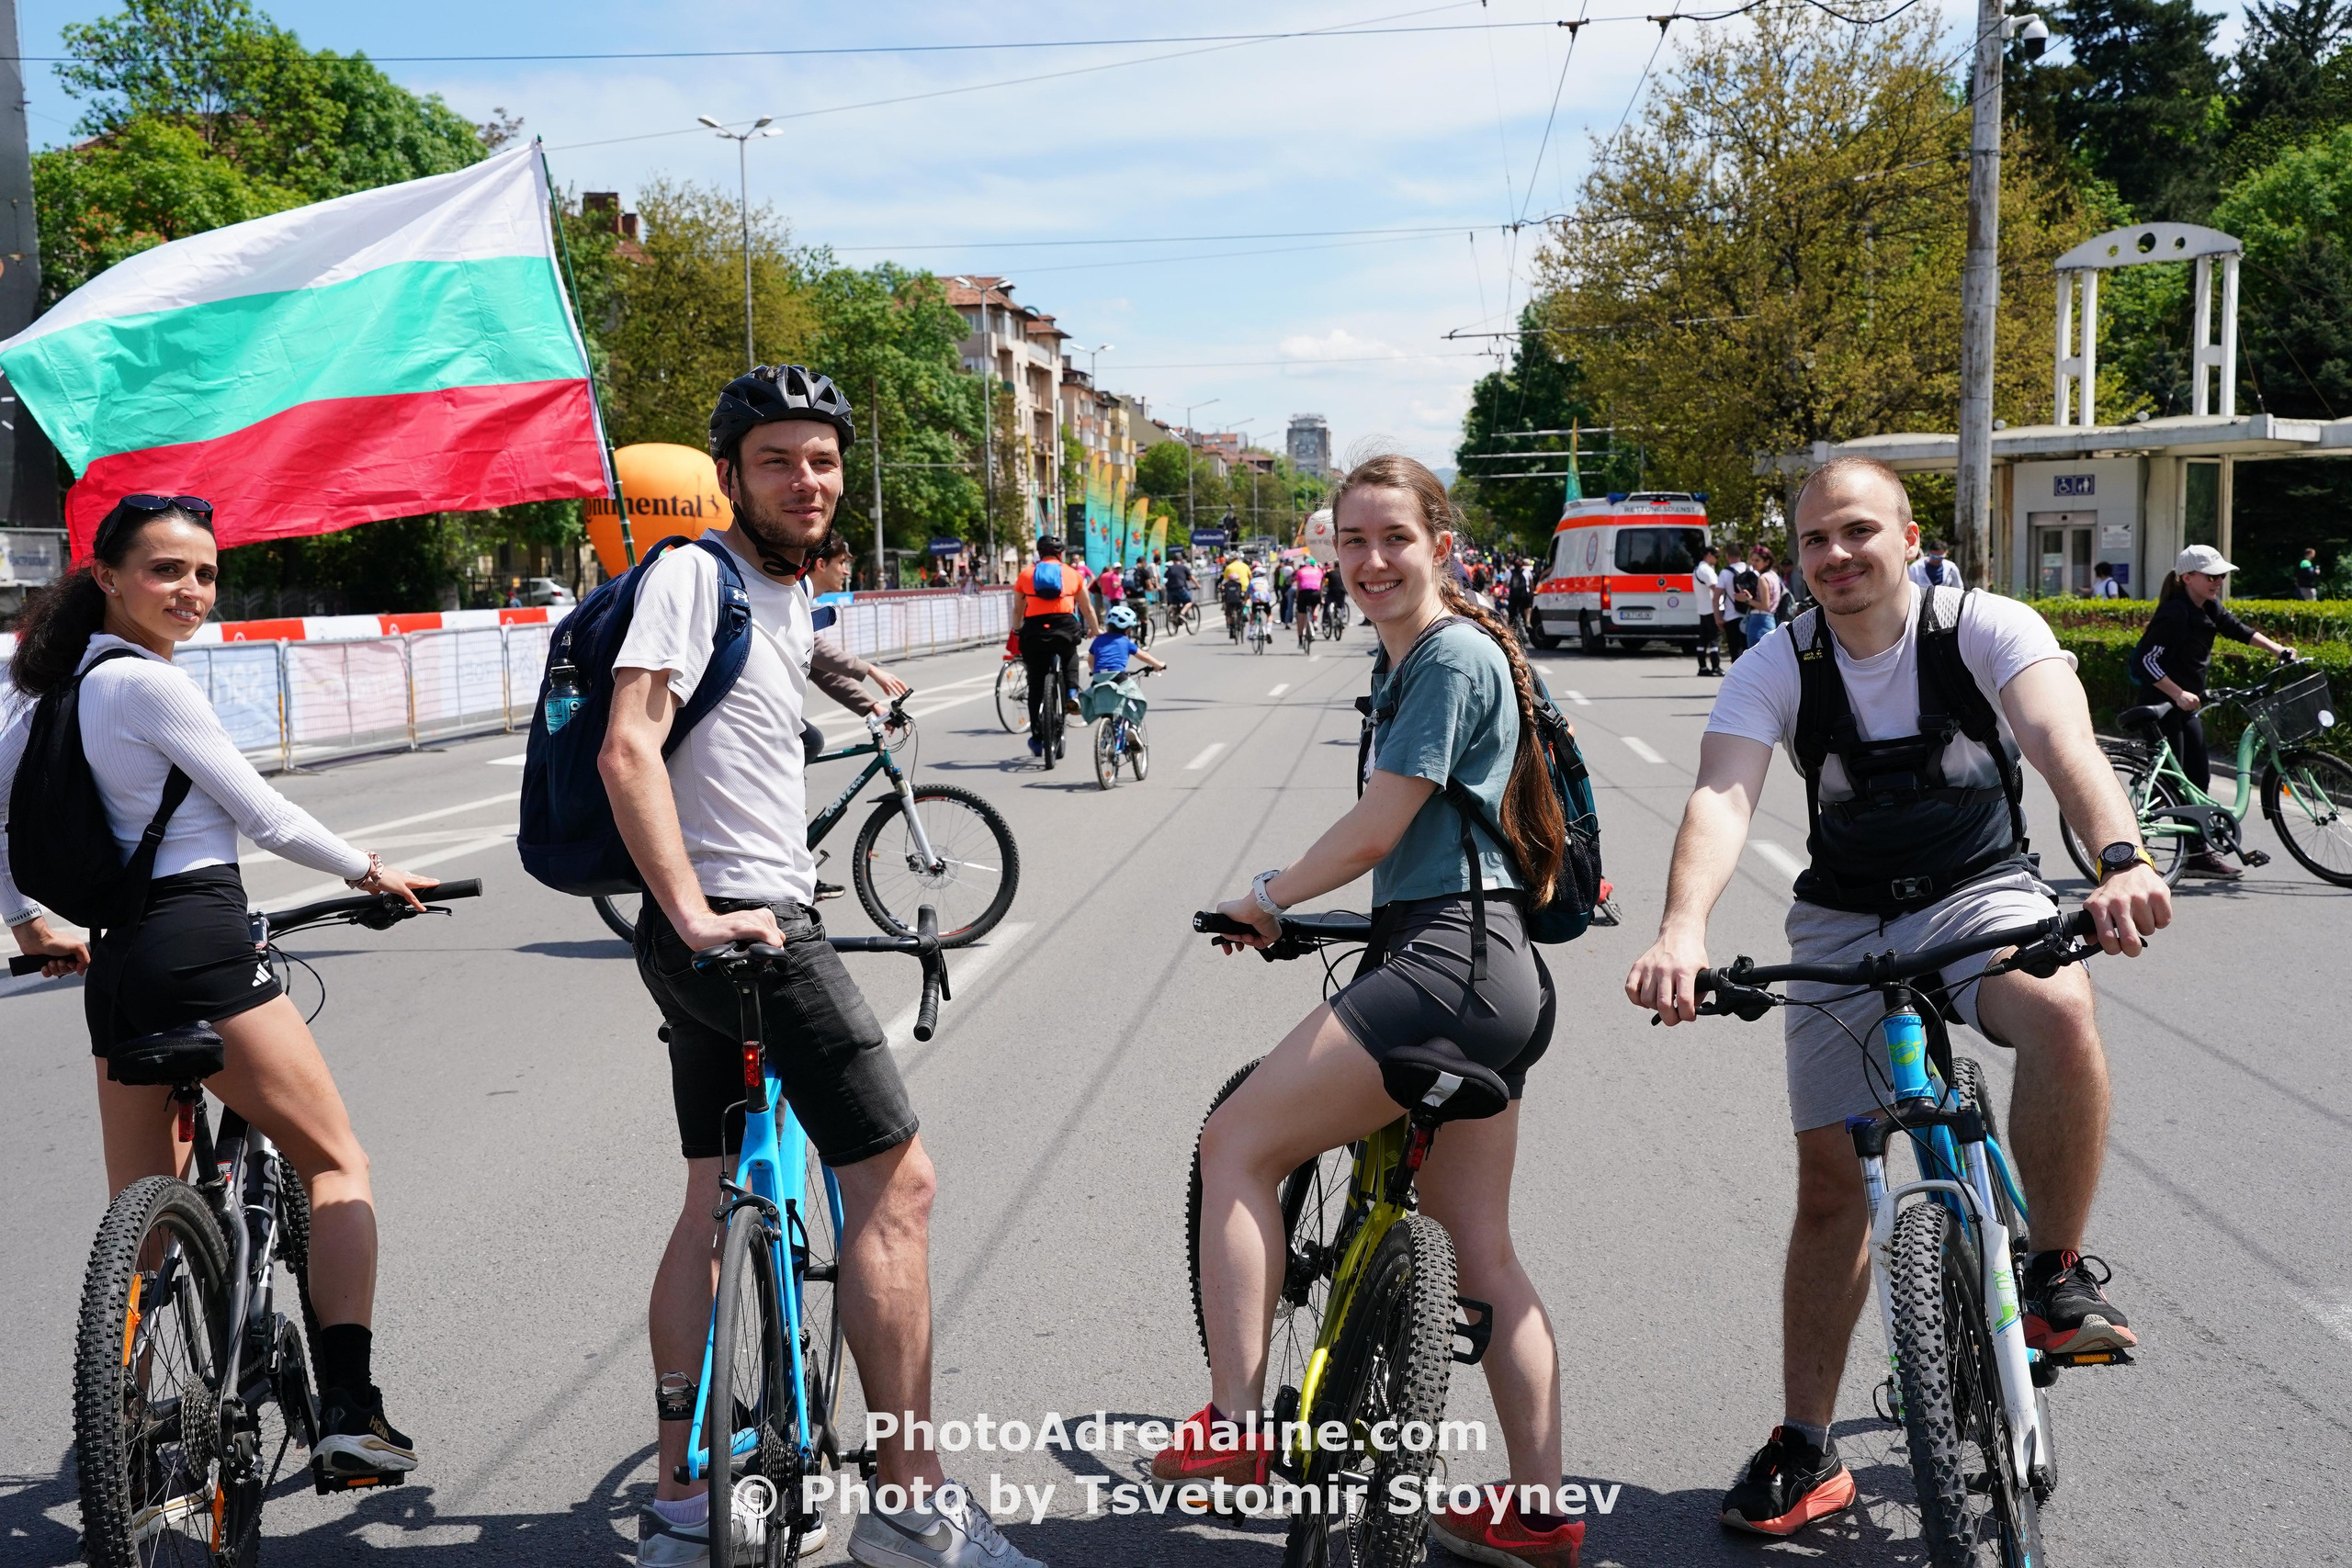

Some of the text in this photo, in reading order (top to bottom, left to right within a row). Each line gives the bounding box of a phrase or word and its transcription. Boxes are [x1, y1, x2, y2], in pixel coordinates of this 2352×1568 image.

[584, 494, 703, 523] ontinental
[1883, 1015, 1921, 1027] PRINT
[368, 1415, 390, 1441] HOKA
